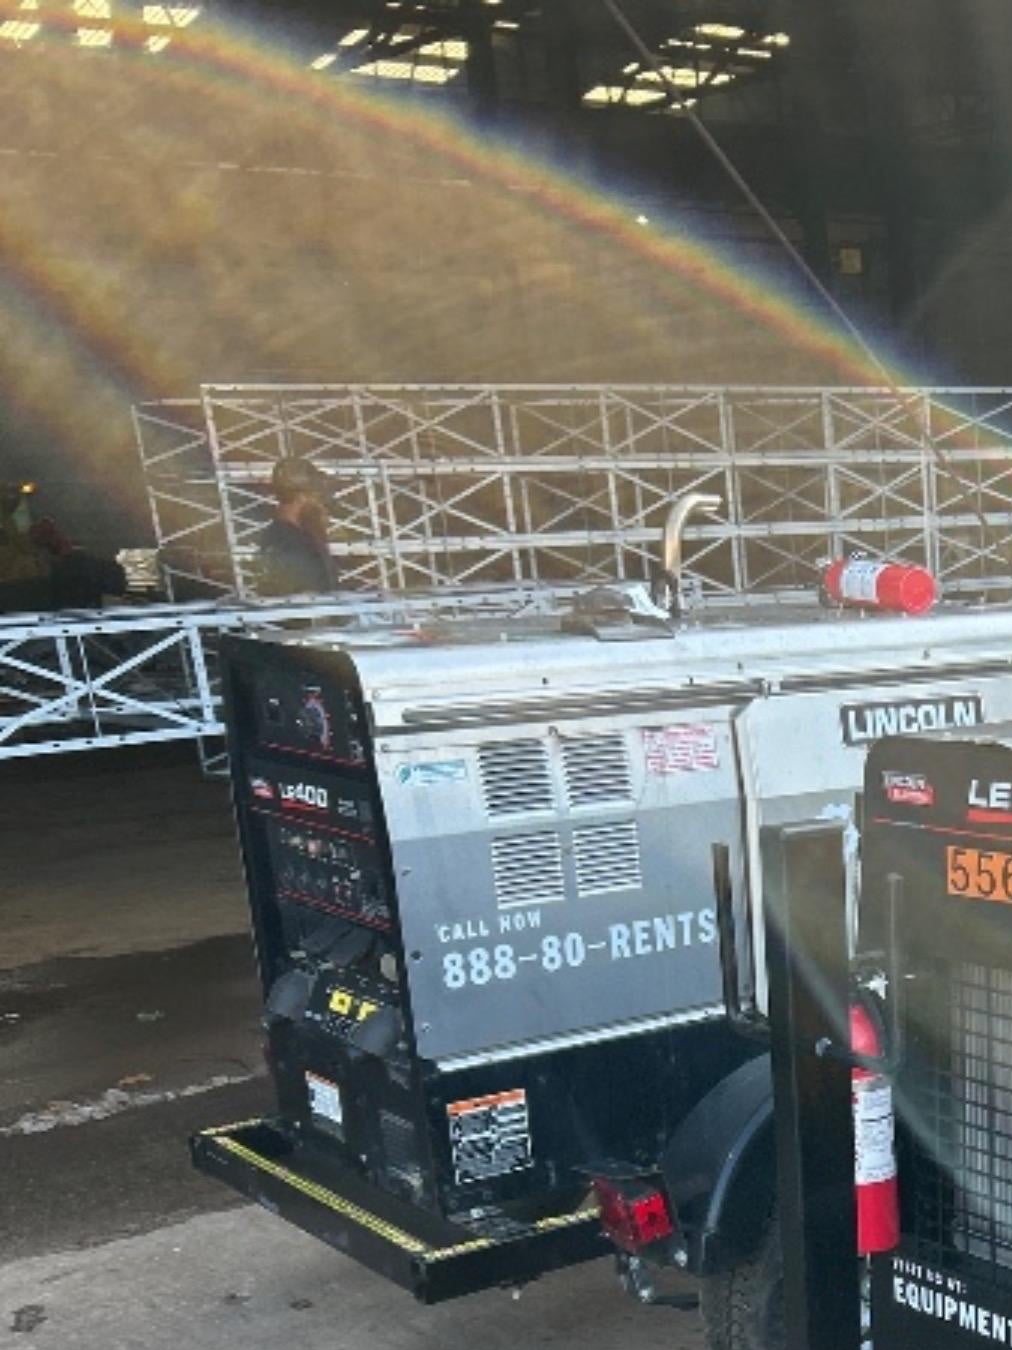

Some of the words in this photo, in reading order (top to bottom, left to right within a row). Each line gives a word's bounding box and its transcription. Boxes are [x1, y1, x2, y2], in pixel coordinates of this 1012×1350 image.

[847, 699, 976, 742] LINCOLN
[437, 920, 489, 943] CALL
[442, 908, 717, 988] 888-80-RENTS
